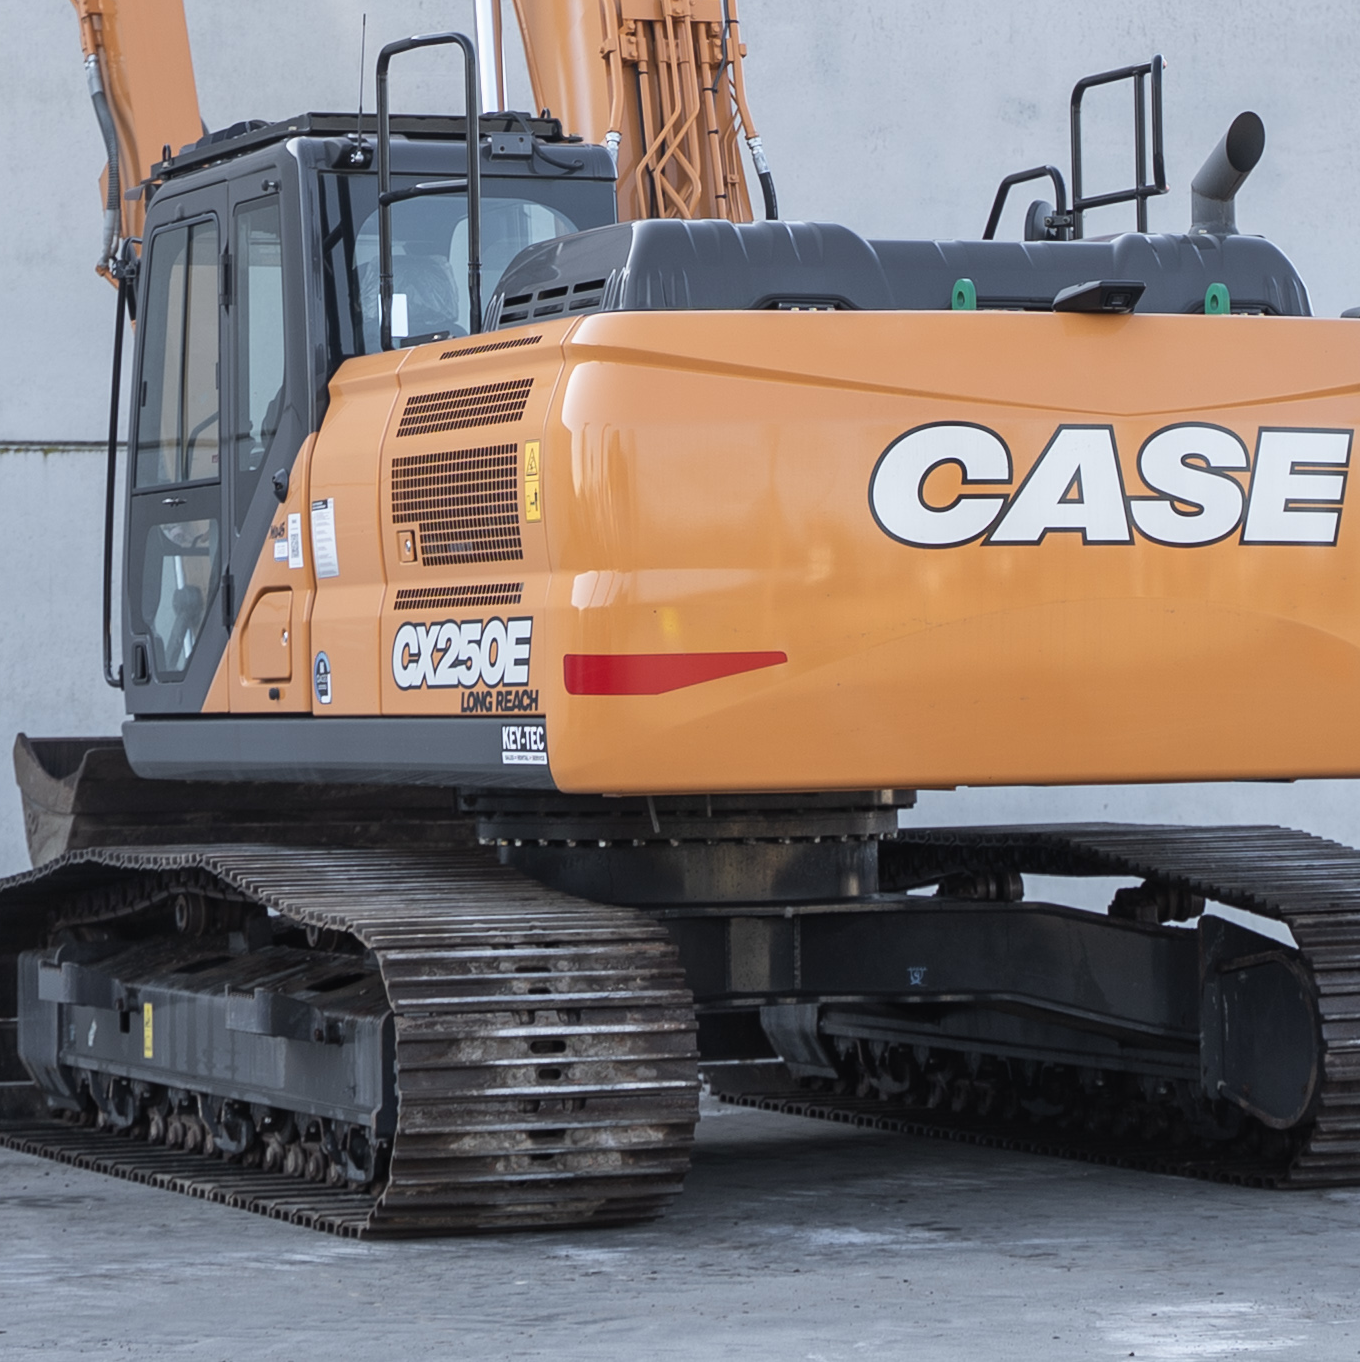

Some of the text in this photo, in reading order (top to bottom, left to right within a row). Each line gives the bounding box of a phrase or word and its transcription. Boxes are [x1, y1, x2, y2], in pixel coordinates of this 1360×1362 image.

[867, 420, 1355, 550] CASE
[391, 615, 534, 690] CX250E
[460, 690, 539, 713] LONG REACH
[501, 725, 545, 751] KEY-TEC
